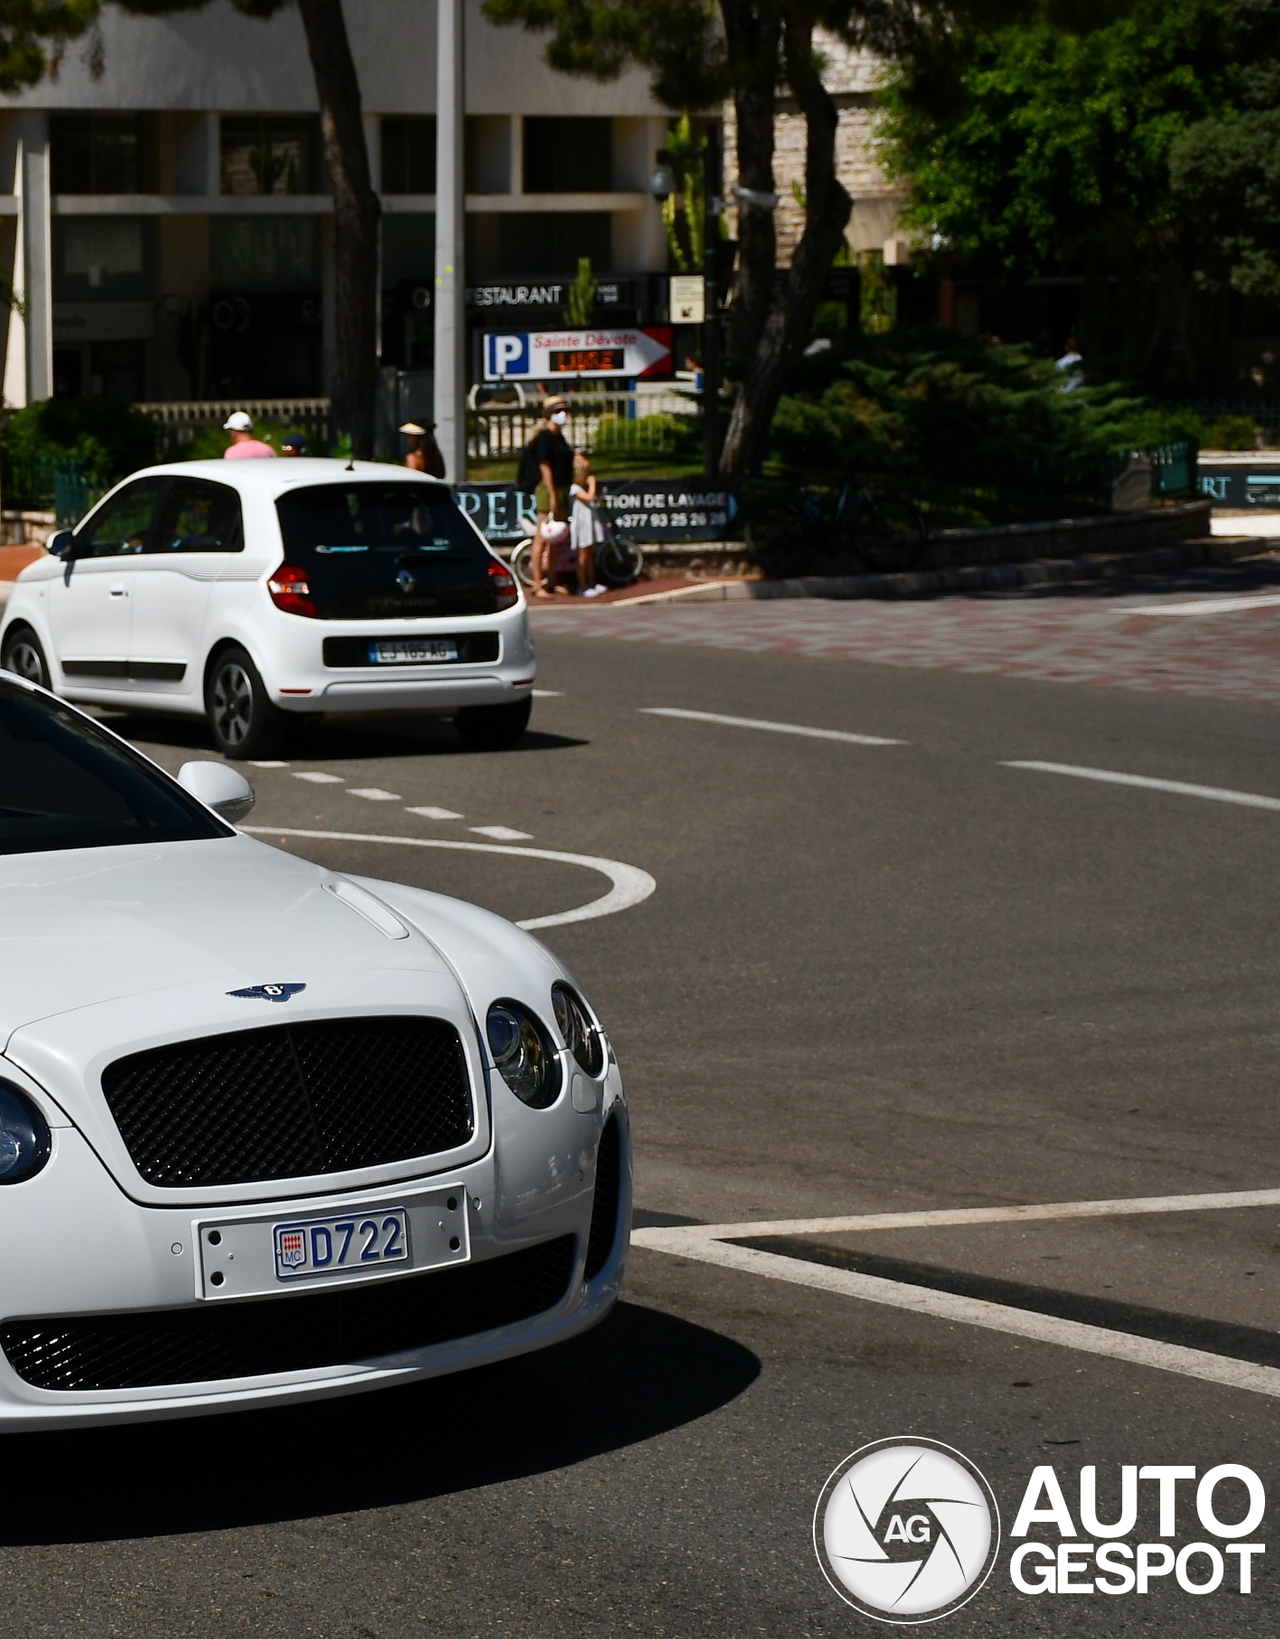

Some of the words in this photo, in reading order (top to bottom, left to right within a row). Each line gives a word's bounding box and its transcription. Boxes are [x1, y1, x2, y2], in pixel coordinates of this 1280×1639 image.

[535, 333, 579, 348] Sainte
[585, 331, 637, 346] Dévote
[494, 334, 523, 373] P
[644, 493, 666, 509] DE
[668, 492, 726, 508] LAVAGE
[615, 513, 648, 528] +377
[650, 513, 668, 528] 93
[285, 1250, 301, 1262] MC
[311, 1216, 403, 1267] D722
